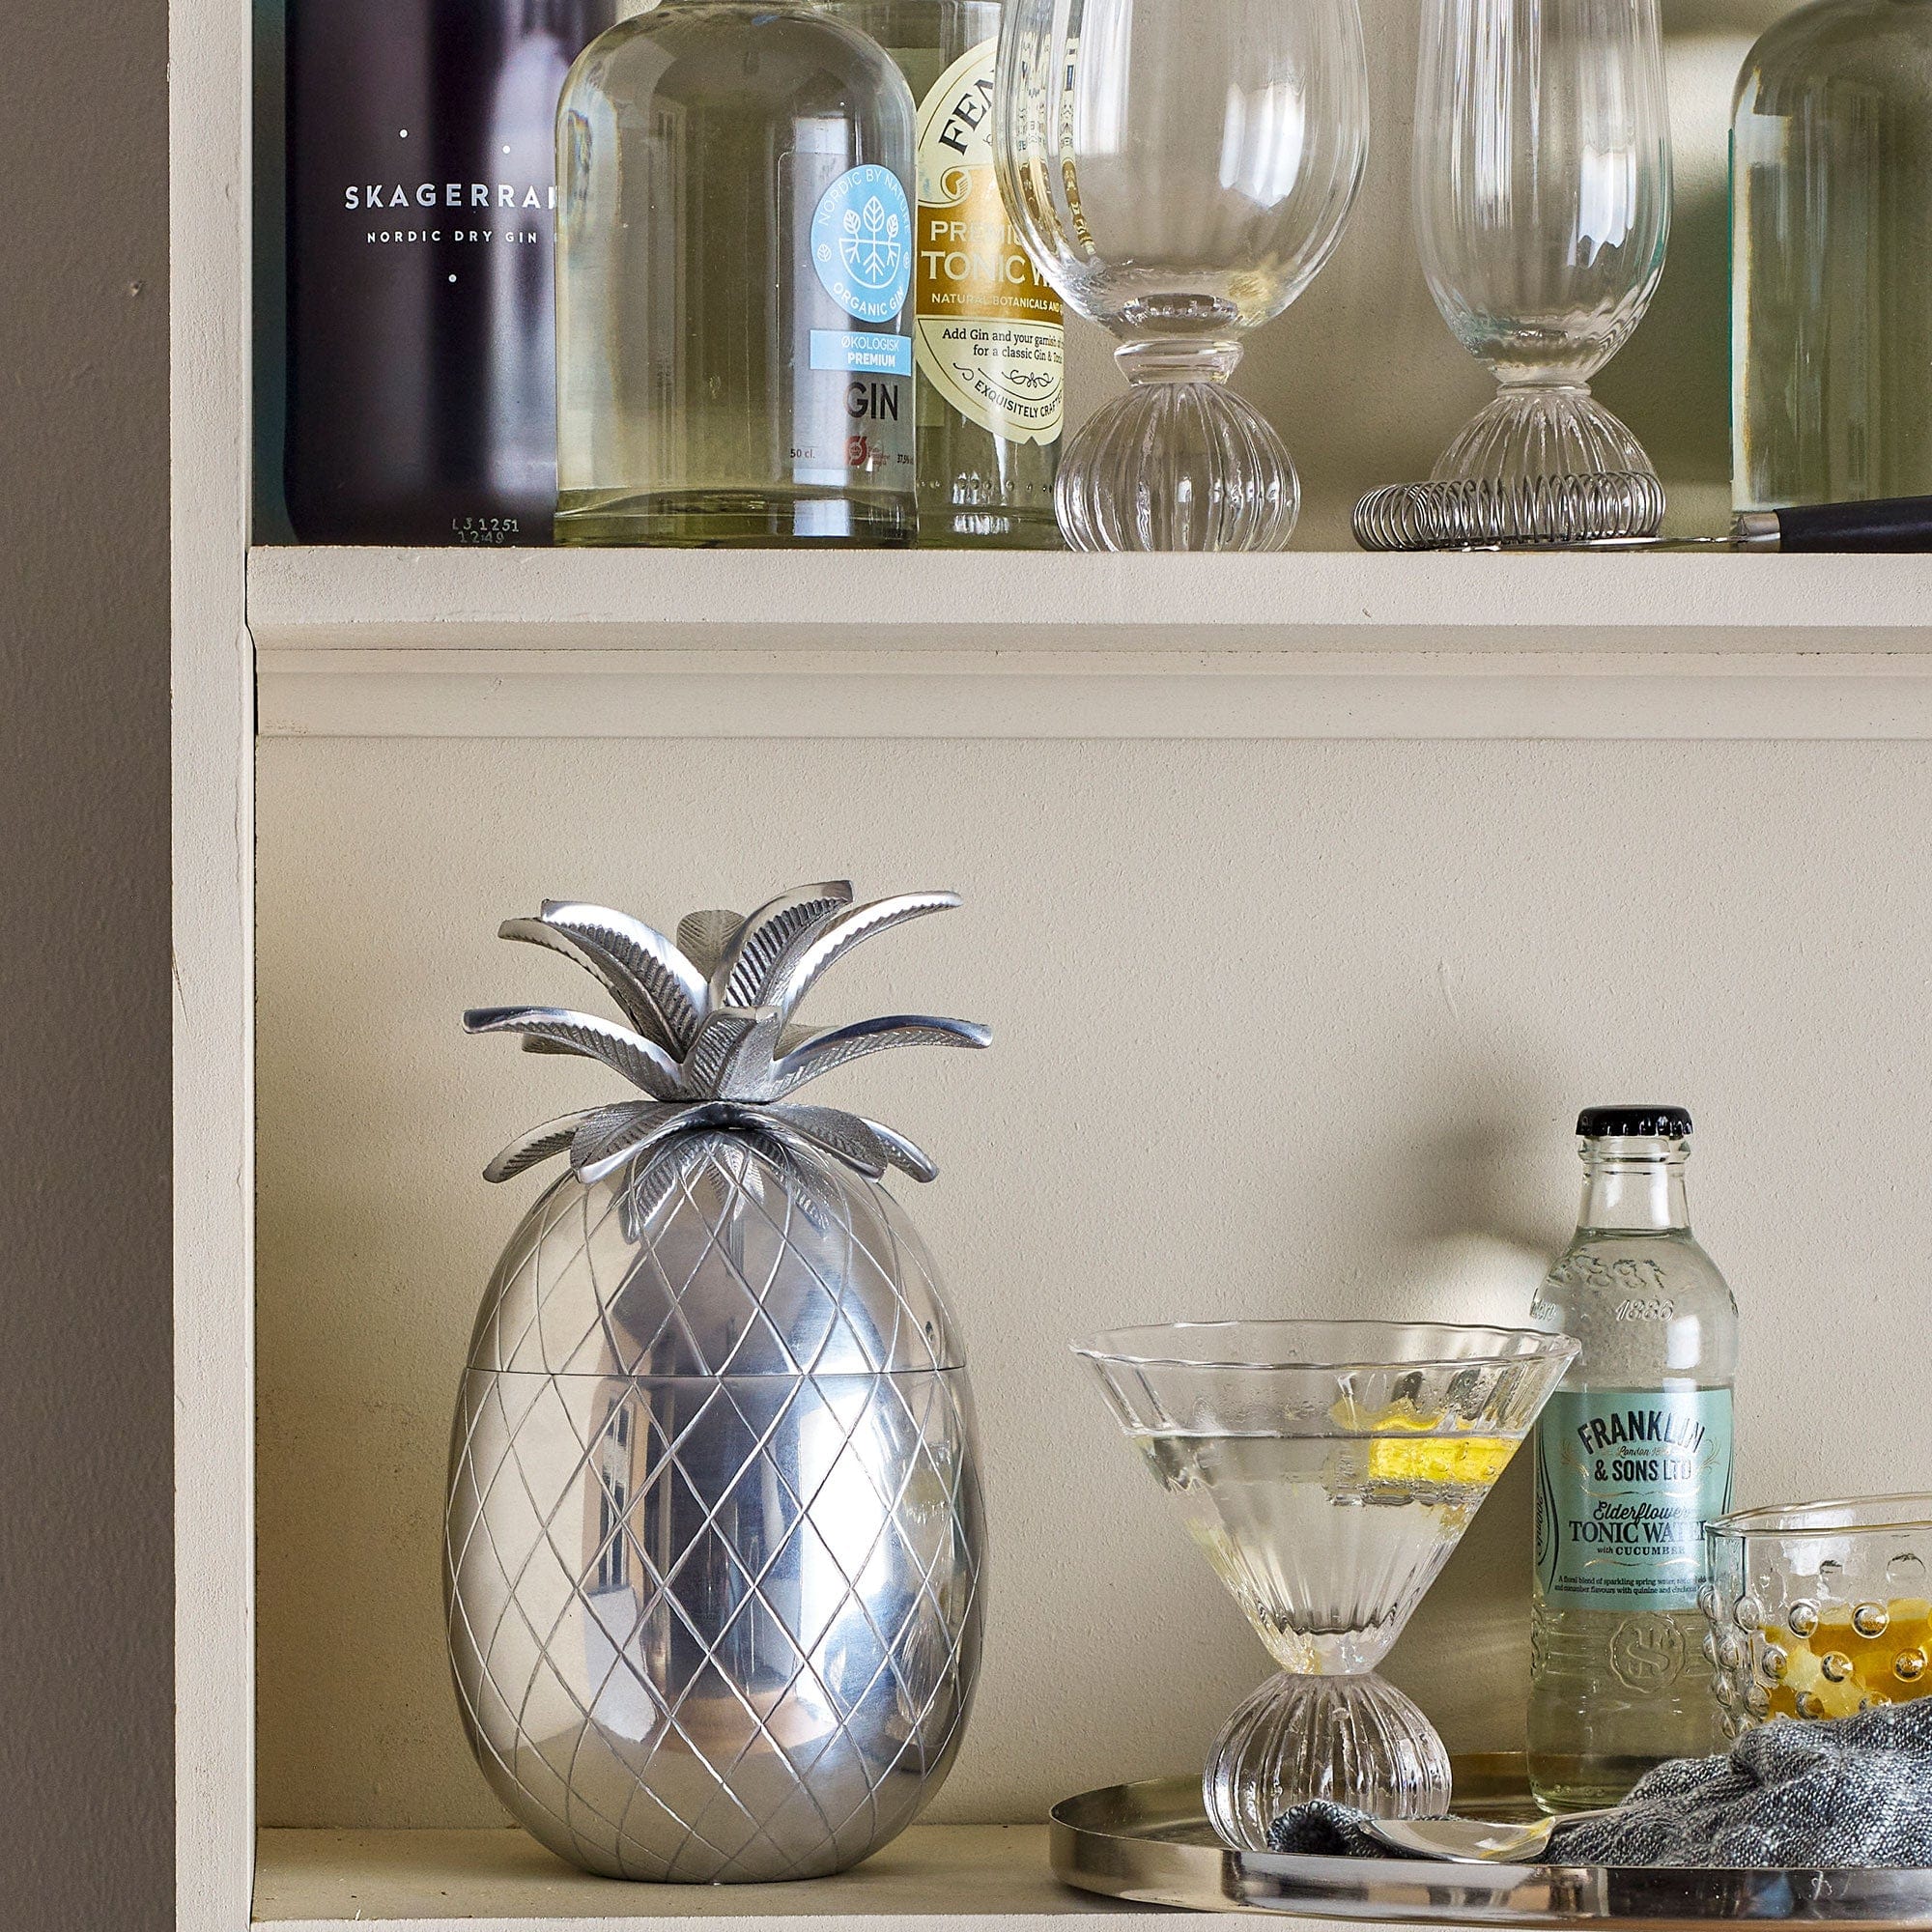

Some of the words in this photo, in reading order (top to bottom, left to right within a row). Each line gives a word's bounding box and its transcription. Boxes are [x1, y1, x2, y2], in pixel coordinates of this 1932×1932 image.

[818, 171, 862, 226] NORDIC
[866, 168, 882, 183] BY
[367, 230, 441, 243] NORDIC
[454, 230, 493, 242] DRY
[505, 231, 538, 243] GIN
[921, 250, 1026, 284] TONIC
[833, 282, 888, 317] ORGANIC
[889, 285, 905, 310] GIN
[931, 293, 990, 305] NATURAL
[992, 295, 1048, 311] BOTANICALS
[840, 335, 900, 352] ØKOLOGISK
[942, 328, 966, 340] Add
[969, 328, 989, 341] Gin
[992, 330, 1011, 342] and
[1013, 333, 1033, 346] your
[847, 352, 895, 367] PREMIUM
[973, 344, 990, 356] for
[992, 348, 999, 356] a
[1002, 346, 1033, 359] classic
[1034, 348, 1046, 361] Gin
[843, 382, 898, 421] GIN
[975, 380, 1038, 418] EXQUISITELY
[1040, 388, 1063, 417] CRAFTE
[790, 448, 802, 459] 50
[1577, 1410, 1706, 1455] FRANKLIN
[1595, 1459, 1608, 1481] &
[1612, 1460, 1660, 1482] SONS
[1662, 1460, 1691, 1481] LTD
[1569, 1520, 1639, 1544] TONIC
[1597, 1546, 1613, 1554] with
